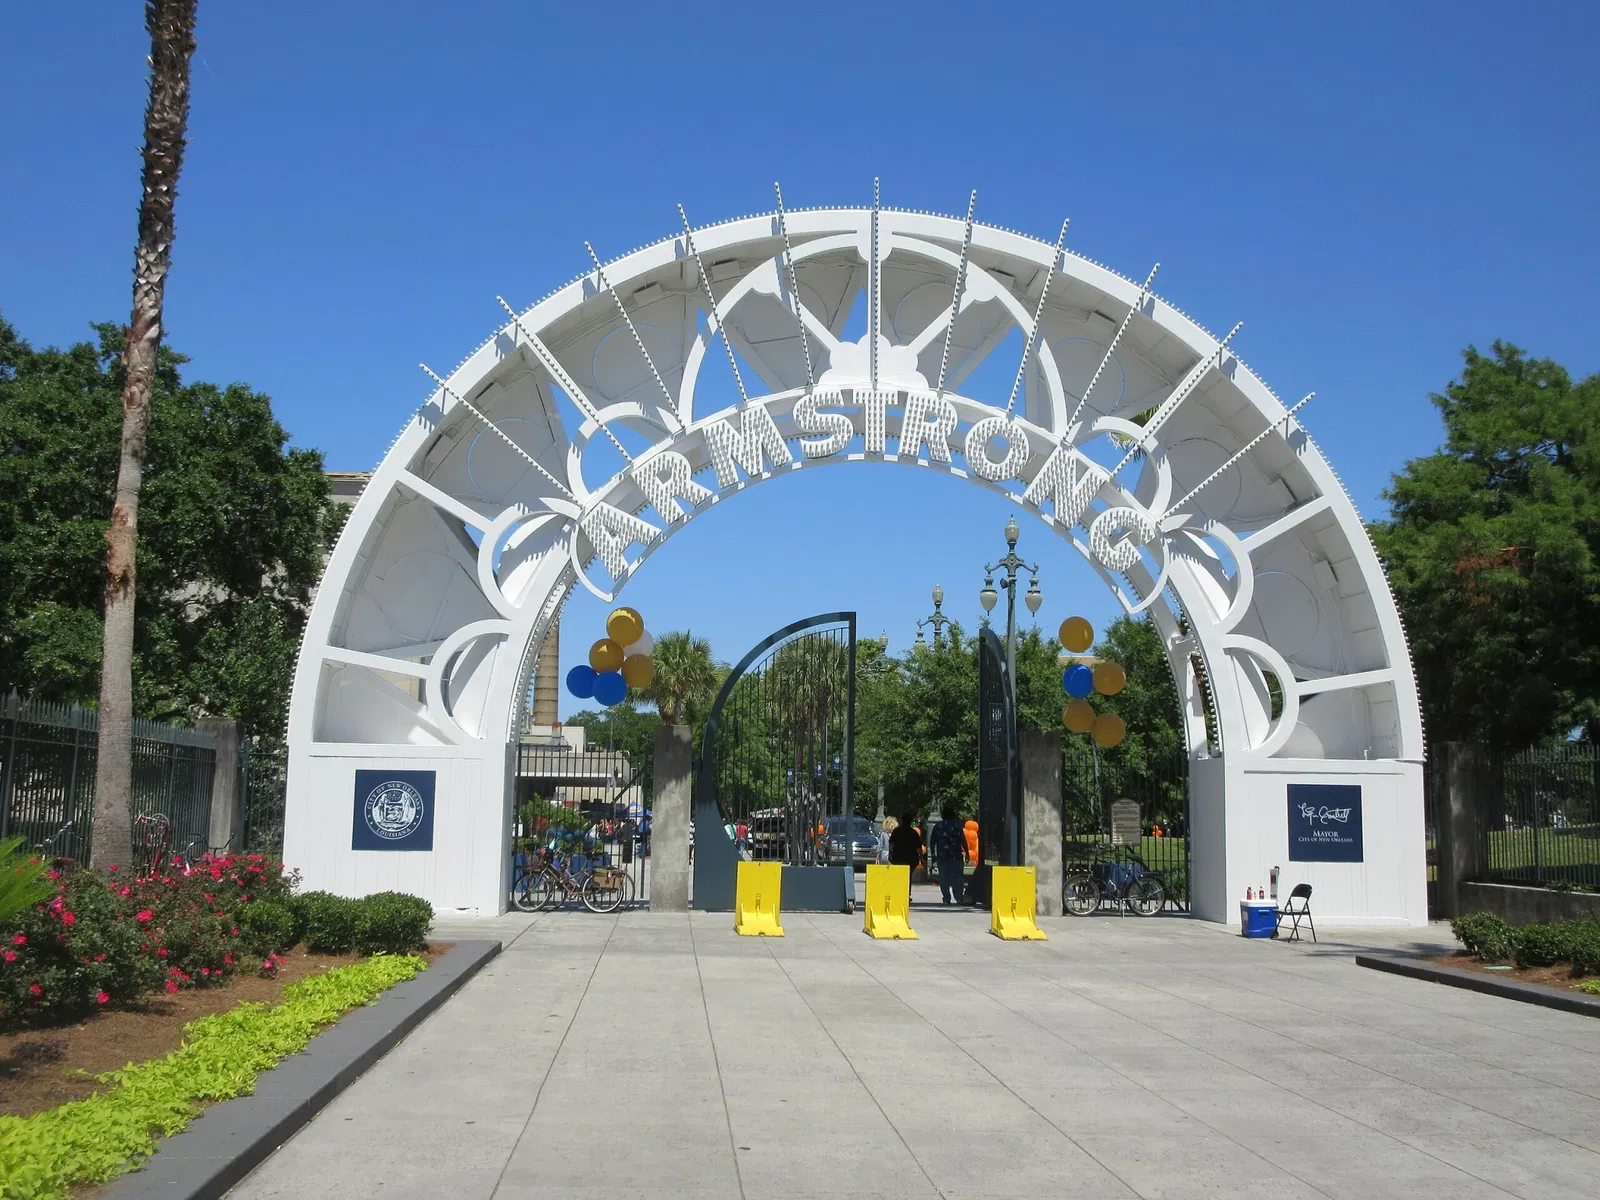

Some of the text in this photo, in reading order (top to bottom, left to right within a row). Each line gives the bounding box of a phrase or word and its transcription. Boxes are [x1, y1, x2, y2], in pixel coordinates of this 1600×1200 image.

[579, 389, 1156, 579] ARMSTRONG
[367, 794, 376, 809] CITY
[403, 785, 421, 810] ORLEANS
[376, 828, 411, 837] LOUISIANA
